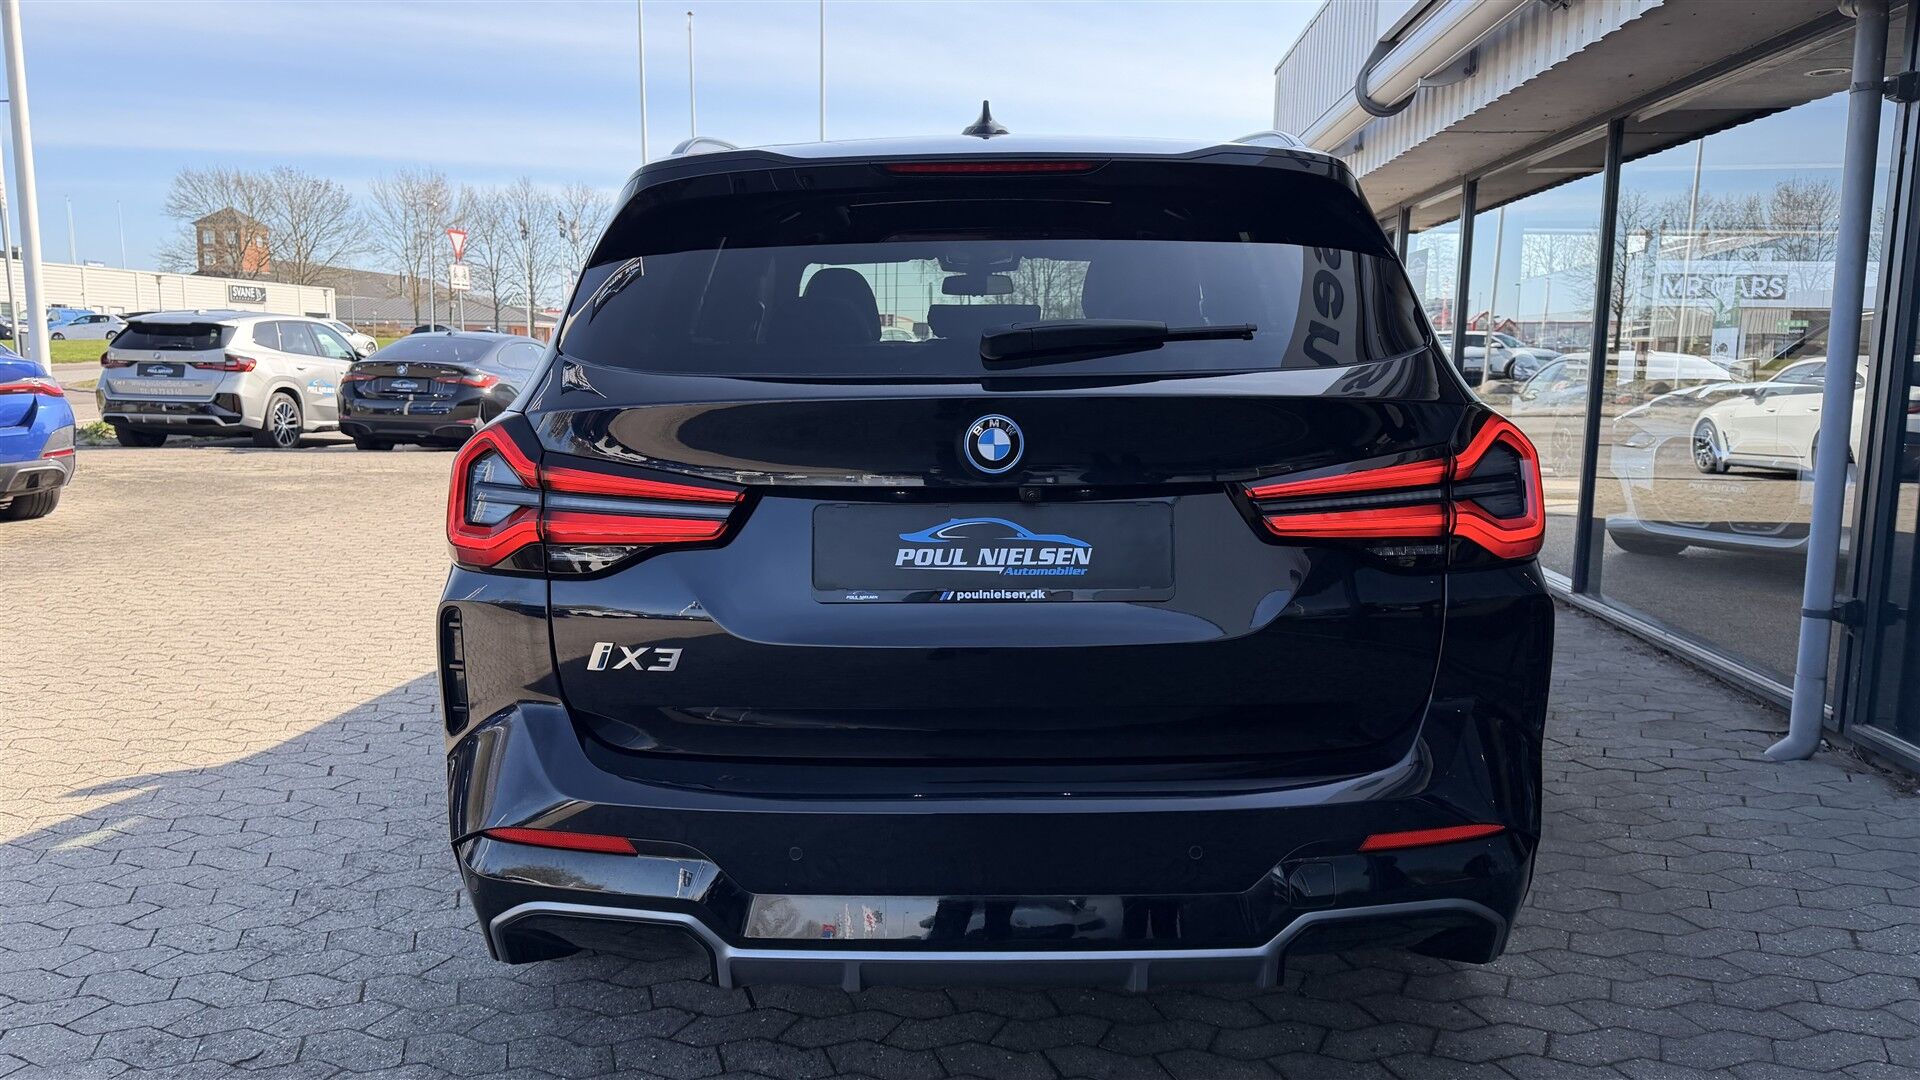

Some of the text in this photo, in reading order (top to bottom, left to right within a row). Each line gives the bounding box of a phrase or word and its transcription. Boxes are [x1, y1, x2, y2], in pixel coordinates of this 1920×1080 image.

[232, 286, 256, 298] SVANE
[973, 419, 1017, 436] BMW
[895, 547, 1093, 566] POUL NIELSEN
[1004, 566, 1088, 576] Automobiler
[957, 589, 1045, 601] poulnielsen.dk
[586, 641, 684, 672] iX3
